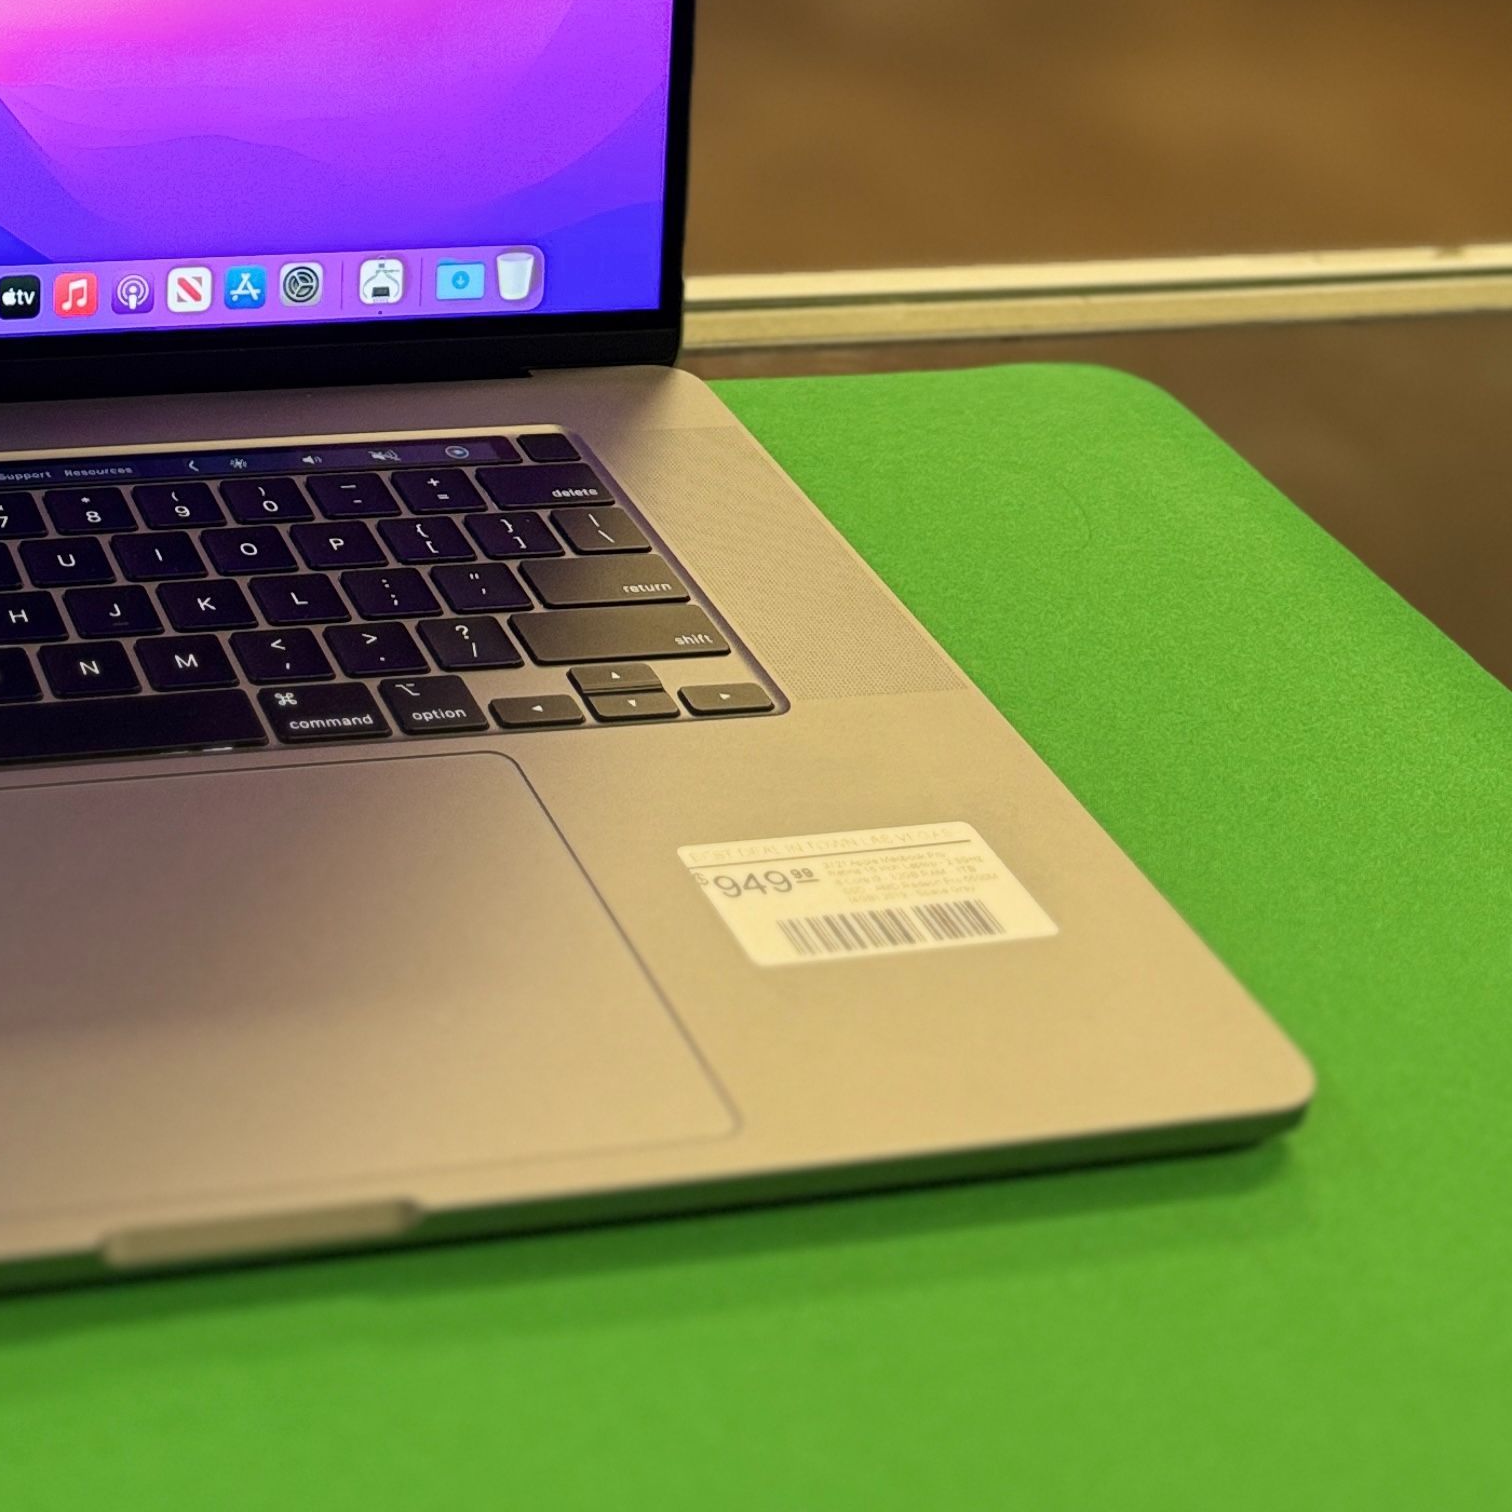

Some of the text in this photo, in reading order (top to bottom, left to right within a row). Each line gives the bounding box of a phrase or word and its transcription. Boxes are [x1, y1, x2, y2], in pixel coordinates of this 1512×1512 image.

[17, 290, 35, 306] tv
[552, 489, 598, 497] delete
[86, 511, 101, 522] 8
[175, 506, 190, 516] 9
[240, 543, 257, 555] O
[329, 539, 344, 550] P
[57, 554, 75, 566] U
[622, 581, 672, 594] return
[198, 598, 216, 610] K
[291, 592, 308, 604] L
[110, 604, 120, 616] J
[9, 610, 28, 623] H
[675, 634, 712, 644] shift
[175, 654, 198, 668] M
[80, 661, 99, 675] N
[413, 709, 466, 721] option
[290, 714, 373, 729] command
